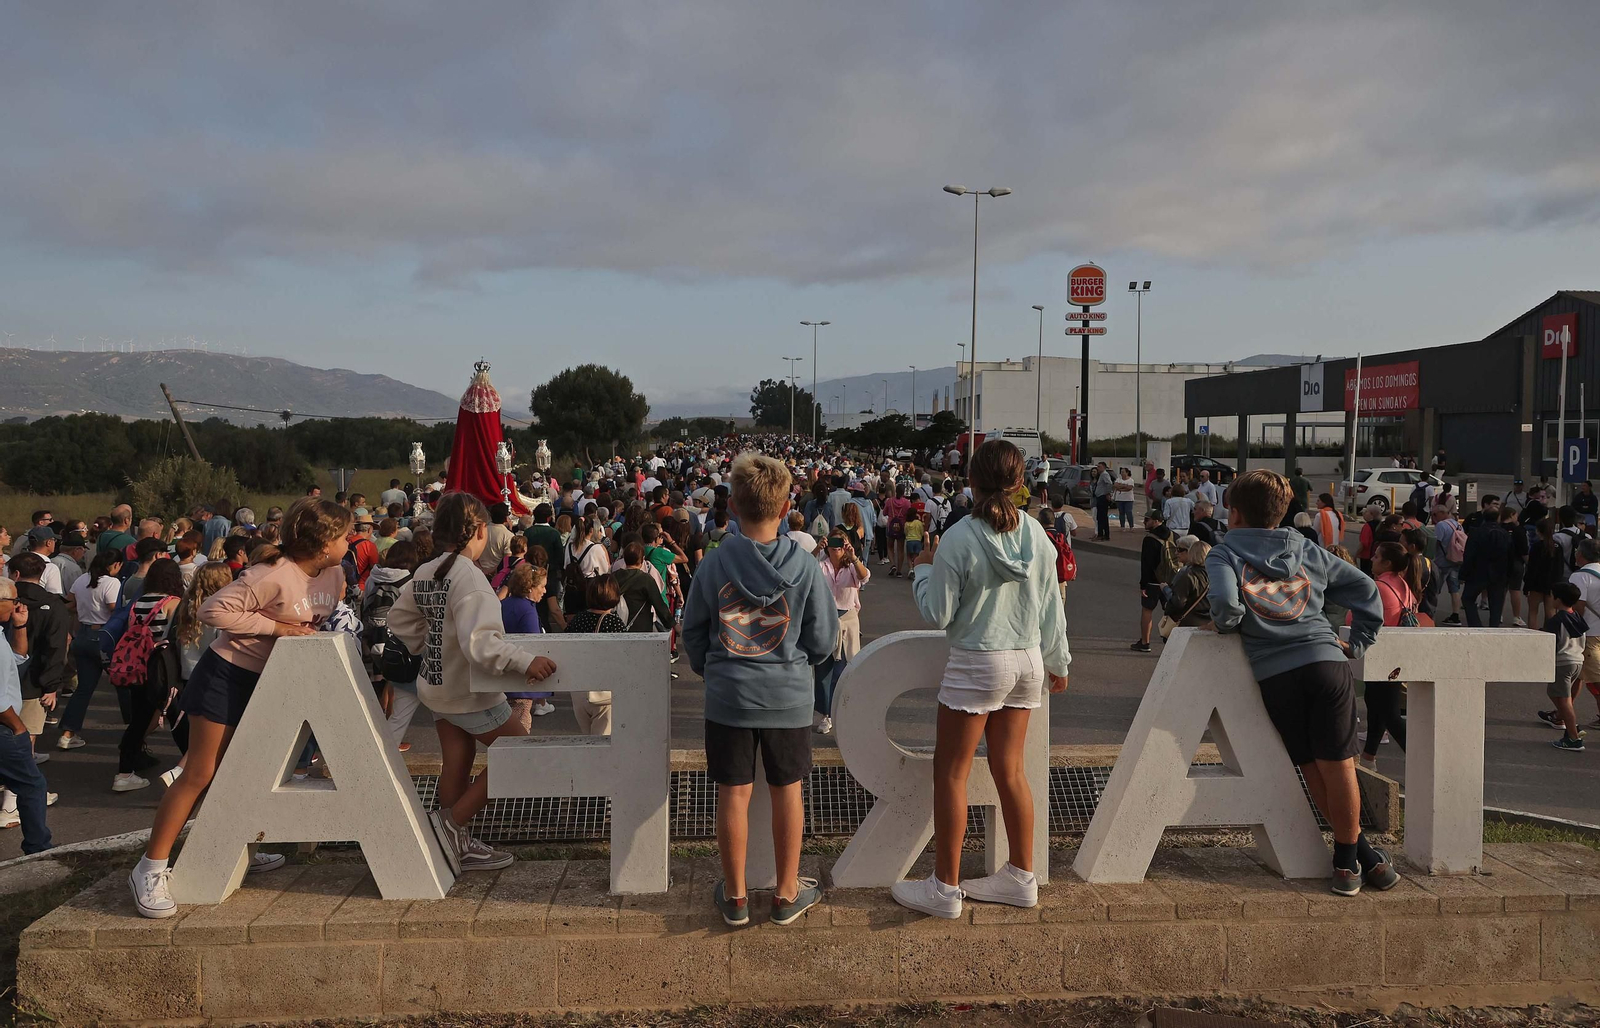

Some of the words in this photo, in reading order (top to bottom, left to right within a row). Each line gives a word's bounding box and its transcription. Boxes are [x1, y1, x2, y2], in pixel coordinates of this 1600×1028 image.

[1071, 278, 1104, 286] BURGER
[1071, 286, 1104, 296] KING
[1346, 376, 1371, 391] ABRMOS
[1372, 376, 1384, 389] LOS
[1385, 373, 1417, 388] DOMINGOS
[1353, 397, 1368, 411] PEN
[1368, 397, 1377, 410] ON
[1378, 395, 1408, 410] SUNDAYS
[1569, 445, 1580, 476] P
